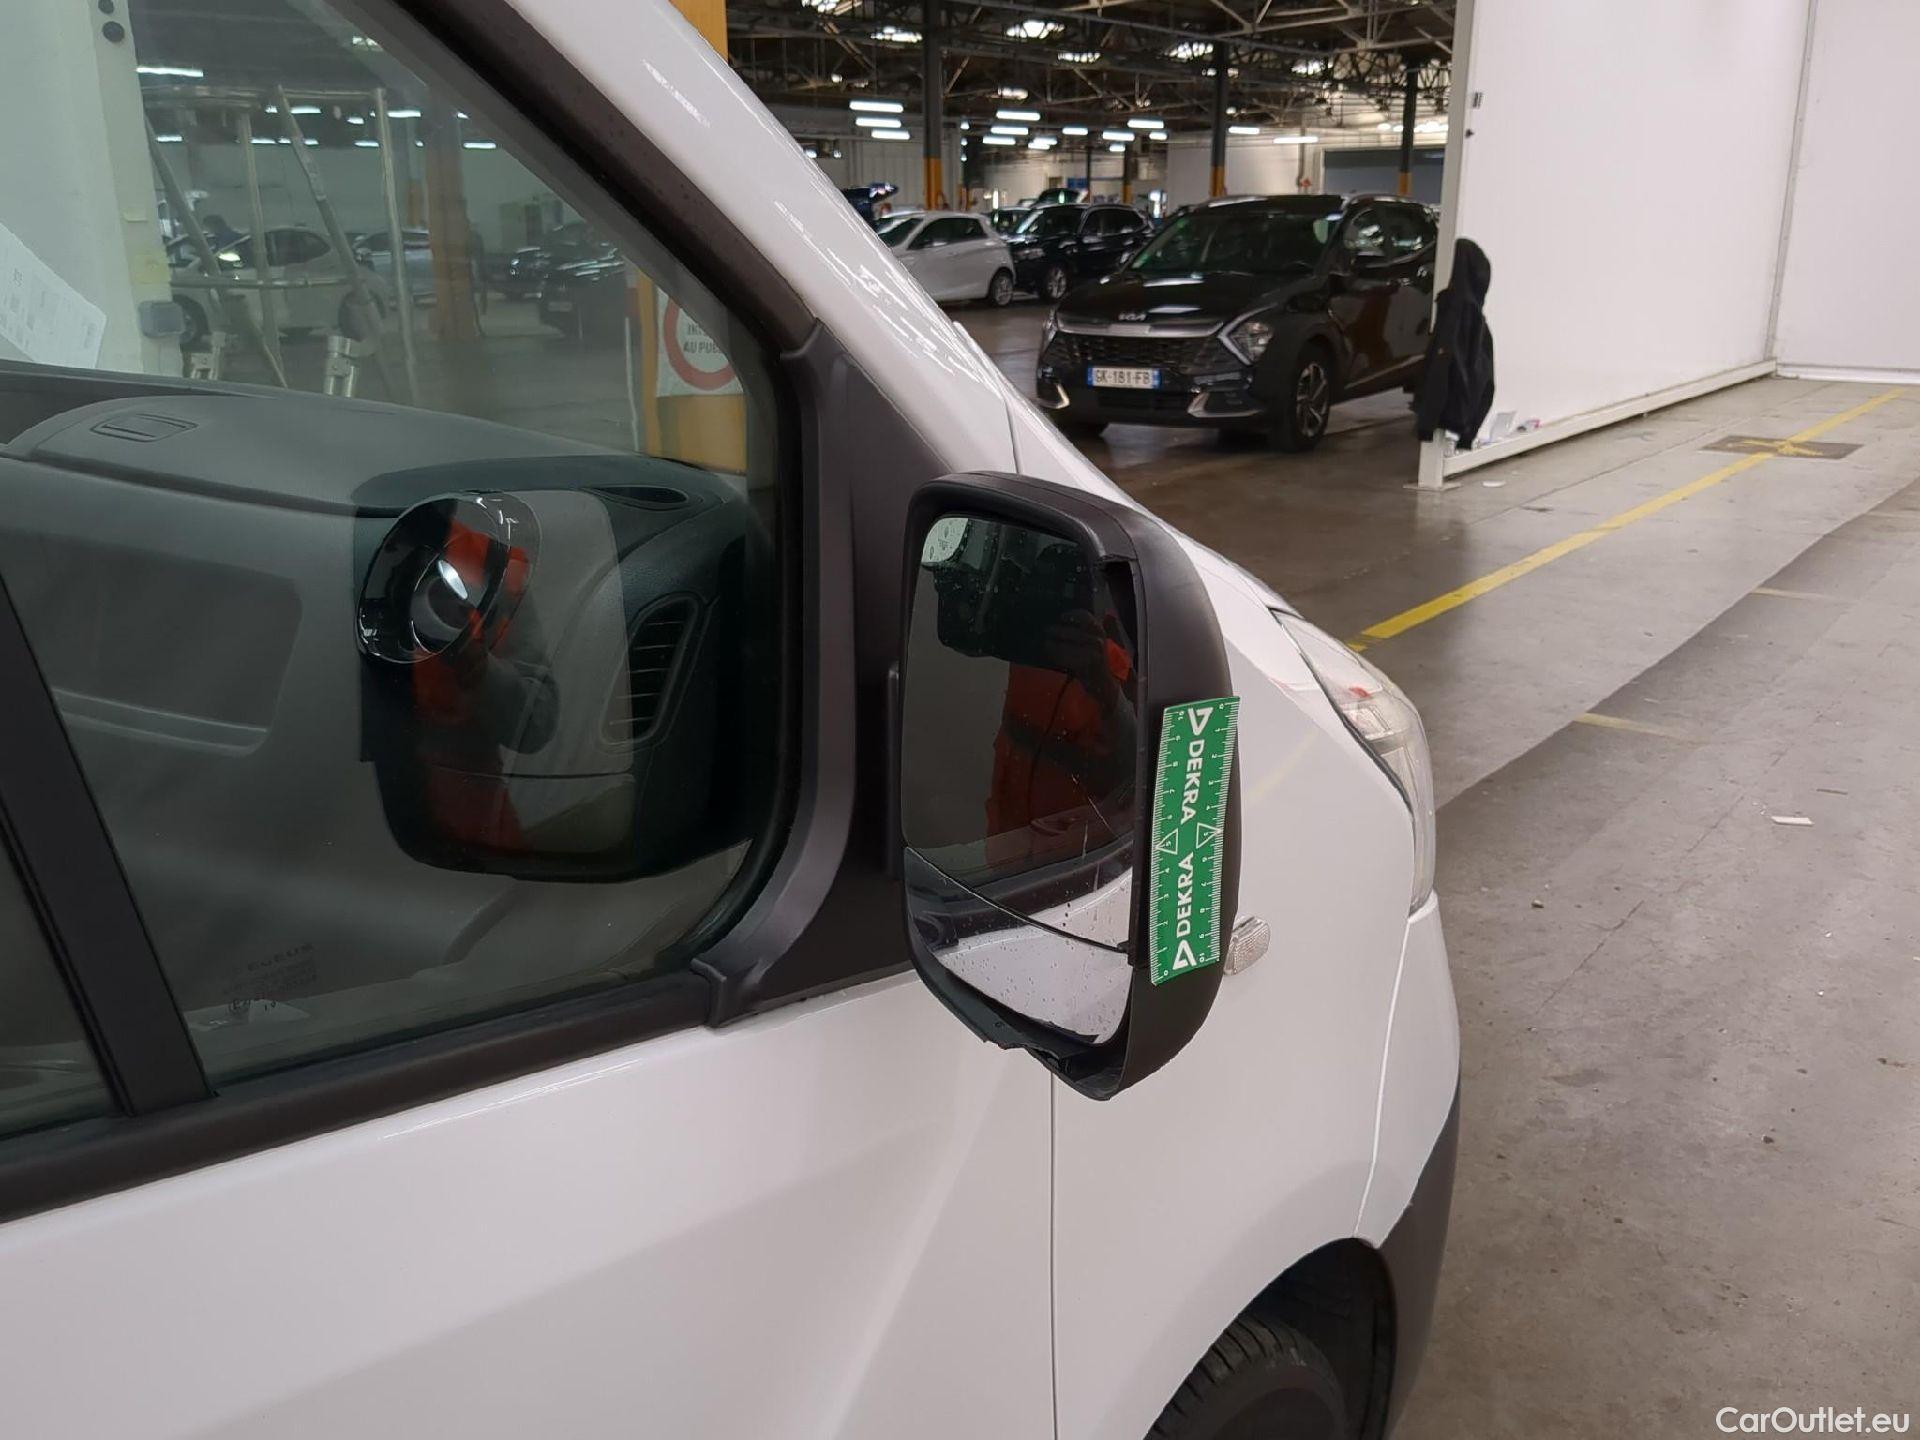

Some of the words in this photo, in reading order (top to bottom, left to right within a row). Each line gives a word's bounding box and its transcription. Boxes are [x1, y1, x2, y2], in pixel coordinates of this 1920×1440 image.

[683, 341, 697, 353] AU
[1181, 738, 1205, 825] DEKRA
[1176, 851, 1194, 939] DEKRA
